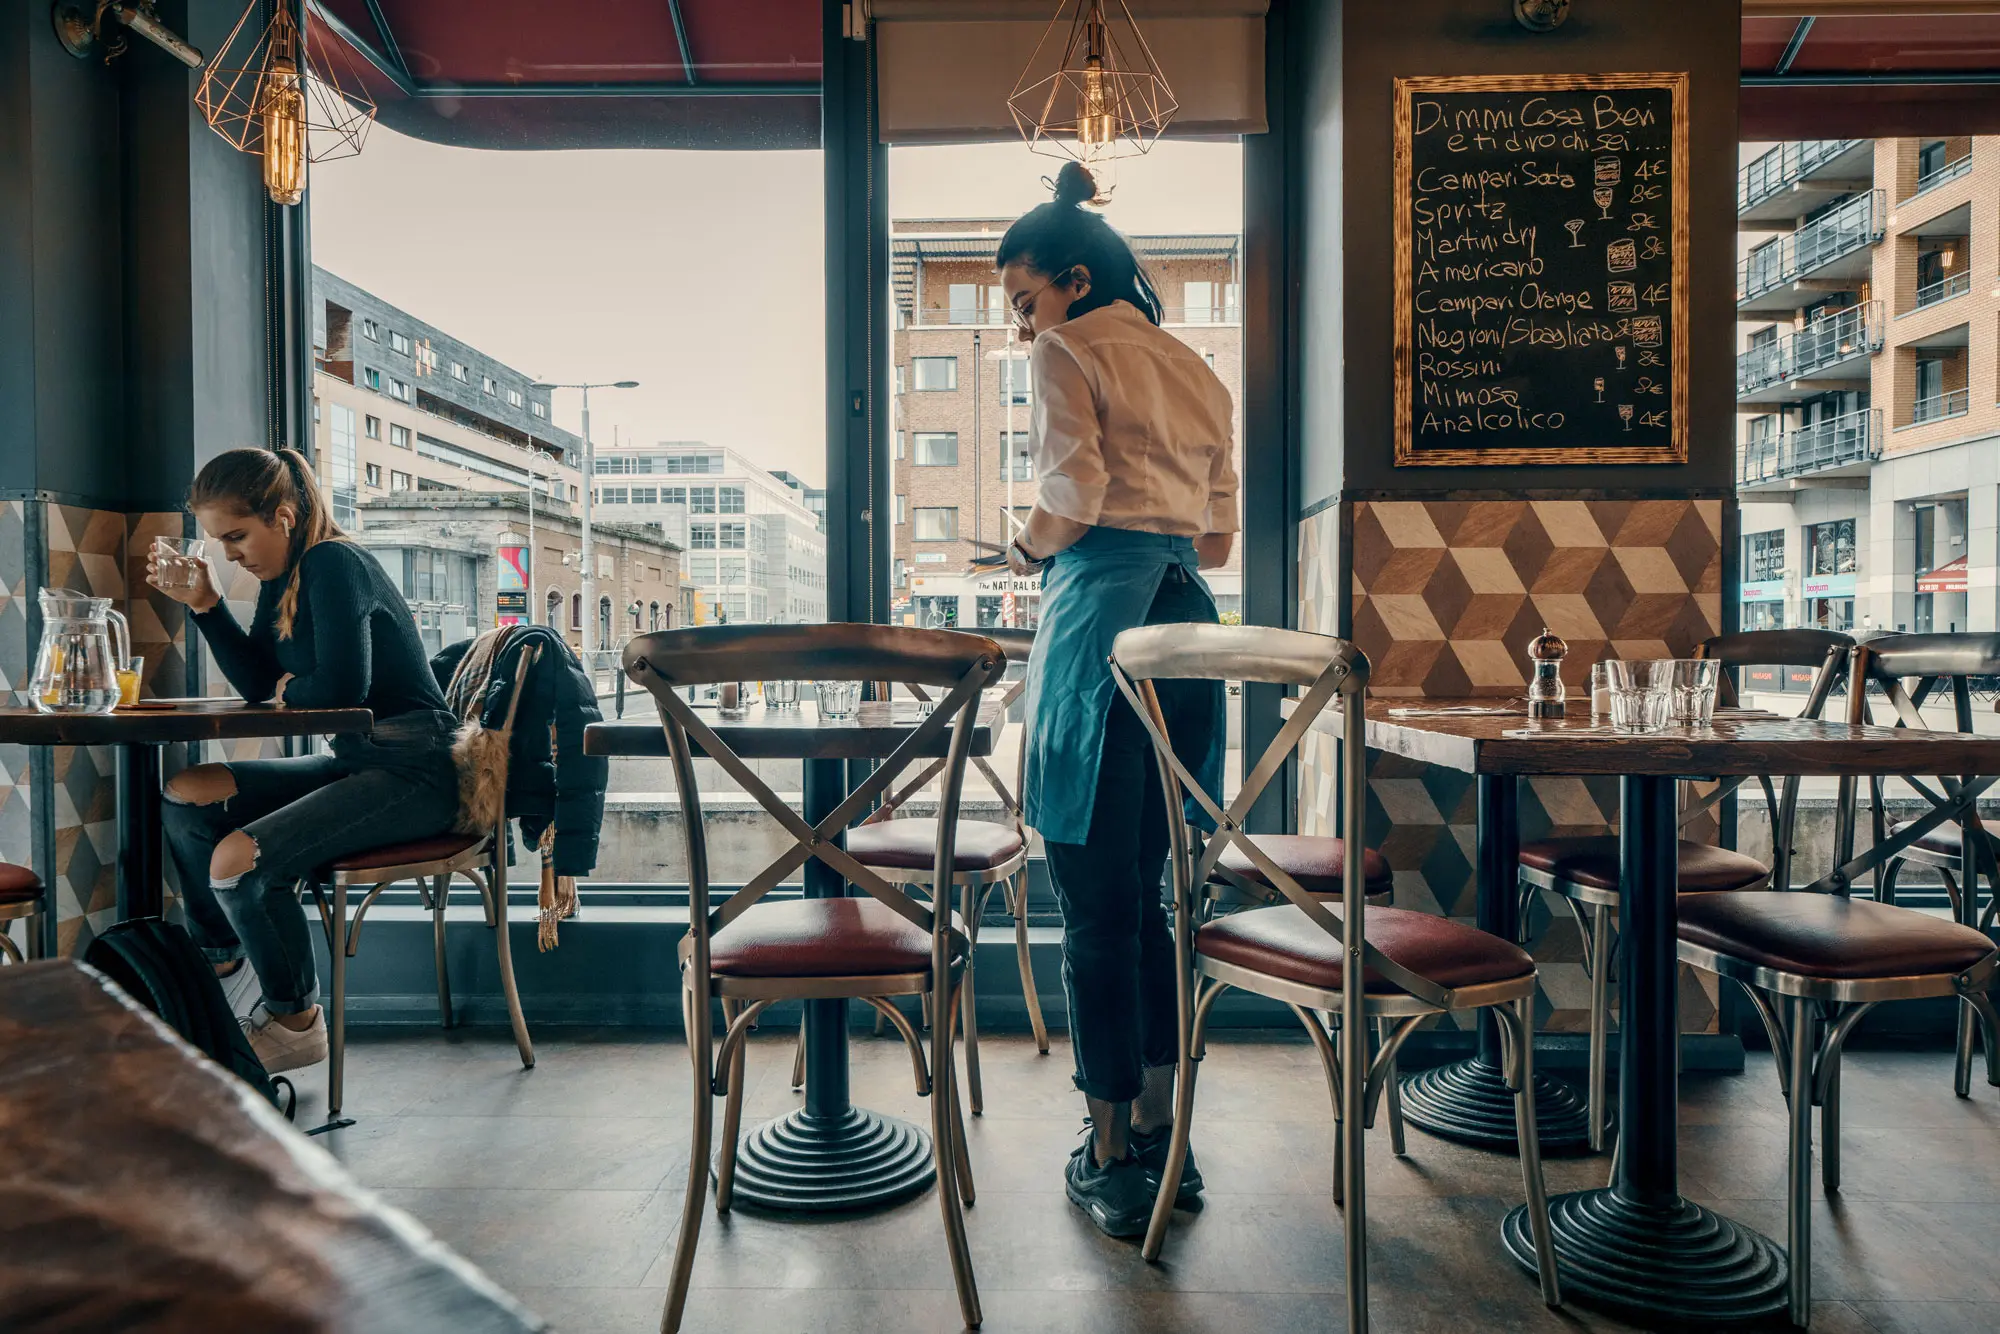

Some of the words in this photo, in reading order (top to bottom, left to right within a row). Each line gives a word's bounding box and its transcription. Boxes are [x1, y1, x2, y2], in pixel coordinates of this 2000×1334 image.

[1415, 100, 1514, 135] Dimmi
[1521, 97, 1585, 127] Cosa
[1594, 95, 1655, 130] Bevi
[1447, 134, 1468, 152] e
[1473, 129, 1497, 151] ti
[1505, 129, 1556, 152] diro
[1562, 129, 1589, 152] chi
[1417, 163, 1517, 202] Campari
[1521, 160, 1576, 188] Soda
[1634, 160, 1667, 180] 4€
[1414, 195, 1506, 230] Spritz
[1630, 184, 1662, 204] 8€
[1417, 225, 1498, 261] Martini
[1502, 217, 1536, 258] dry
[1627, 212, 1660, 232] 8€
[1418, 257, 1544, 285] Americano
[1640, 235, 1666, 260] 8€
[1416, 285, 1514, 324] Campari
[1520, 282, 1594, 315] Orange
[1642, 283, 1670, 307] 4€
[1419, 352, 1502, 383] Rossini
[1637, 350, 1665, 367] 8€
[1424, 381, 1521, 409] Mimosa
[1633, 377, 1664, 394] 8€
[1420, 407, 1566, 435] Analcolico
[1639, 410, 1668, 428] 4€
[979, 582, 990, 590] The
[992, 580, 1029, 591] NATRAL
[1806, 583, 1829, 594] boojum
